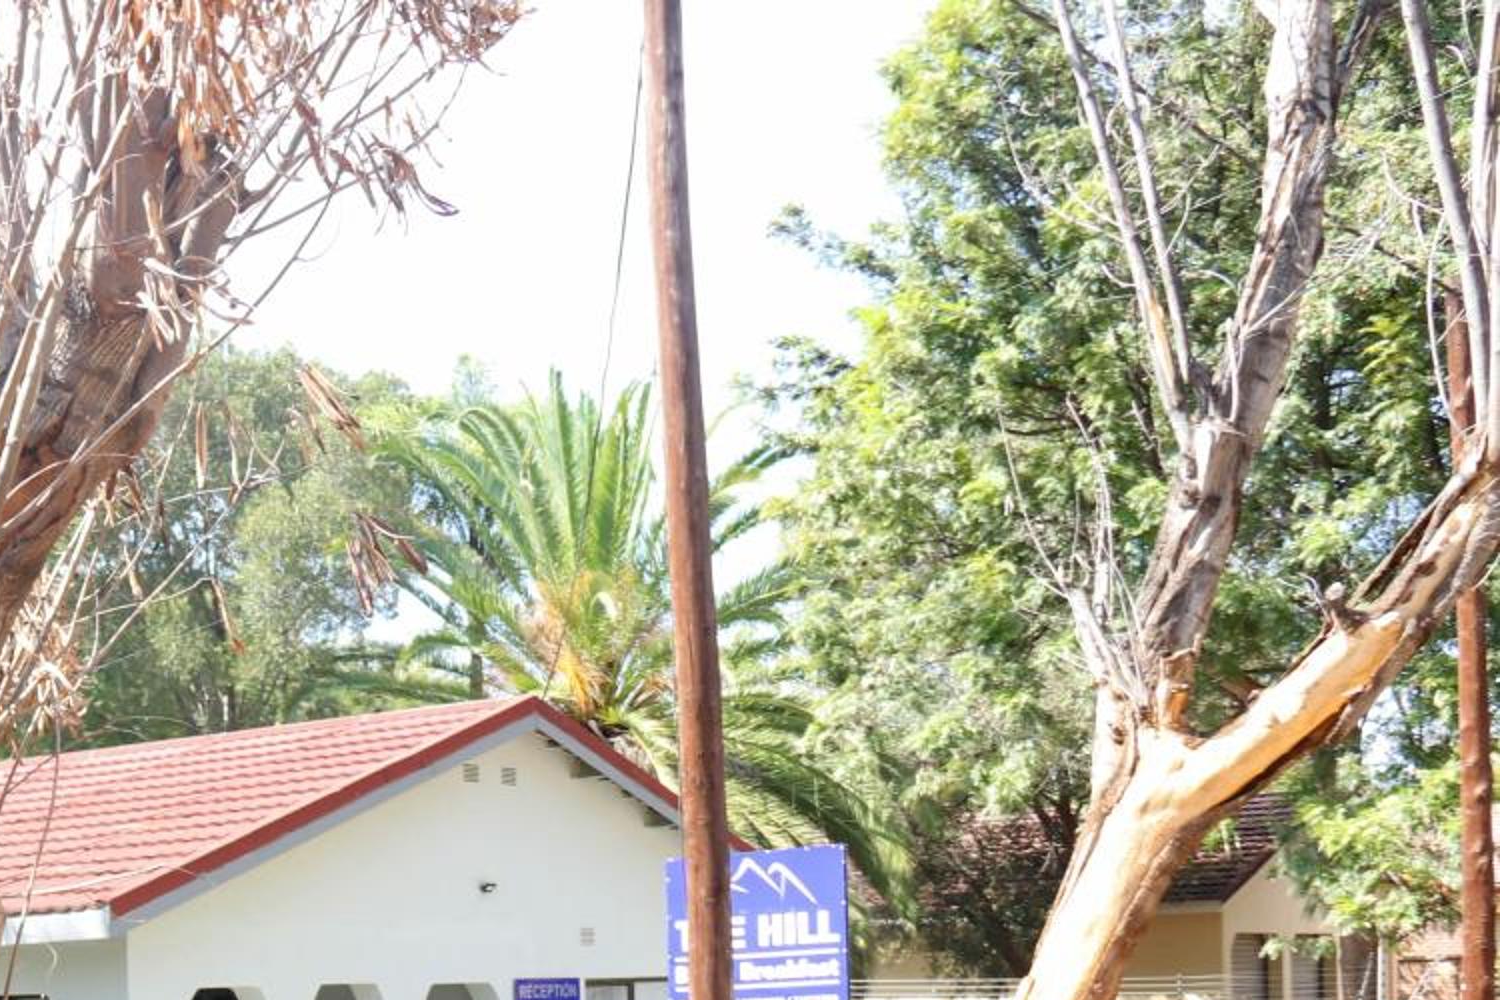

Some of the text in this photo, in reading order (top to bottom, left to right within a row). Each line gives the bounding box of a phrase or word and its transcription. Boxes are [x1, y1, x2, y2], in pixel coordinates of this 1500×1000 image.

[674, 909, 840, 952] TE HILL
[519, 983, 578, 999] RECEPTION
